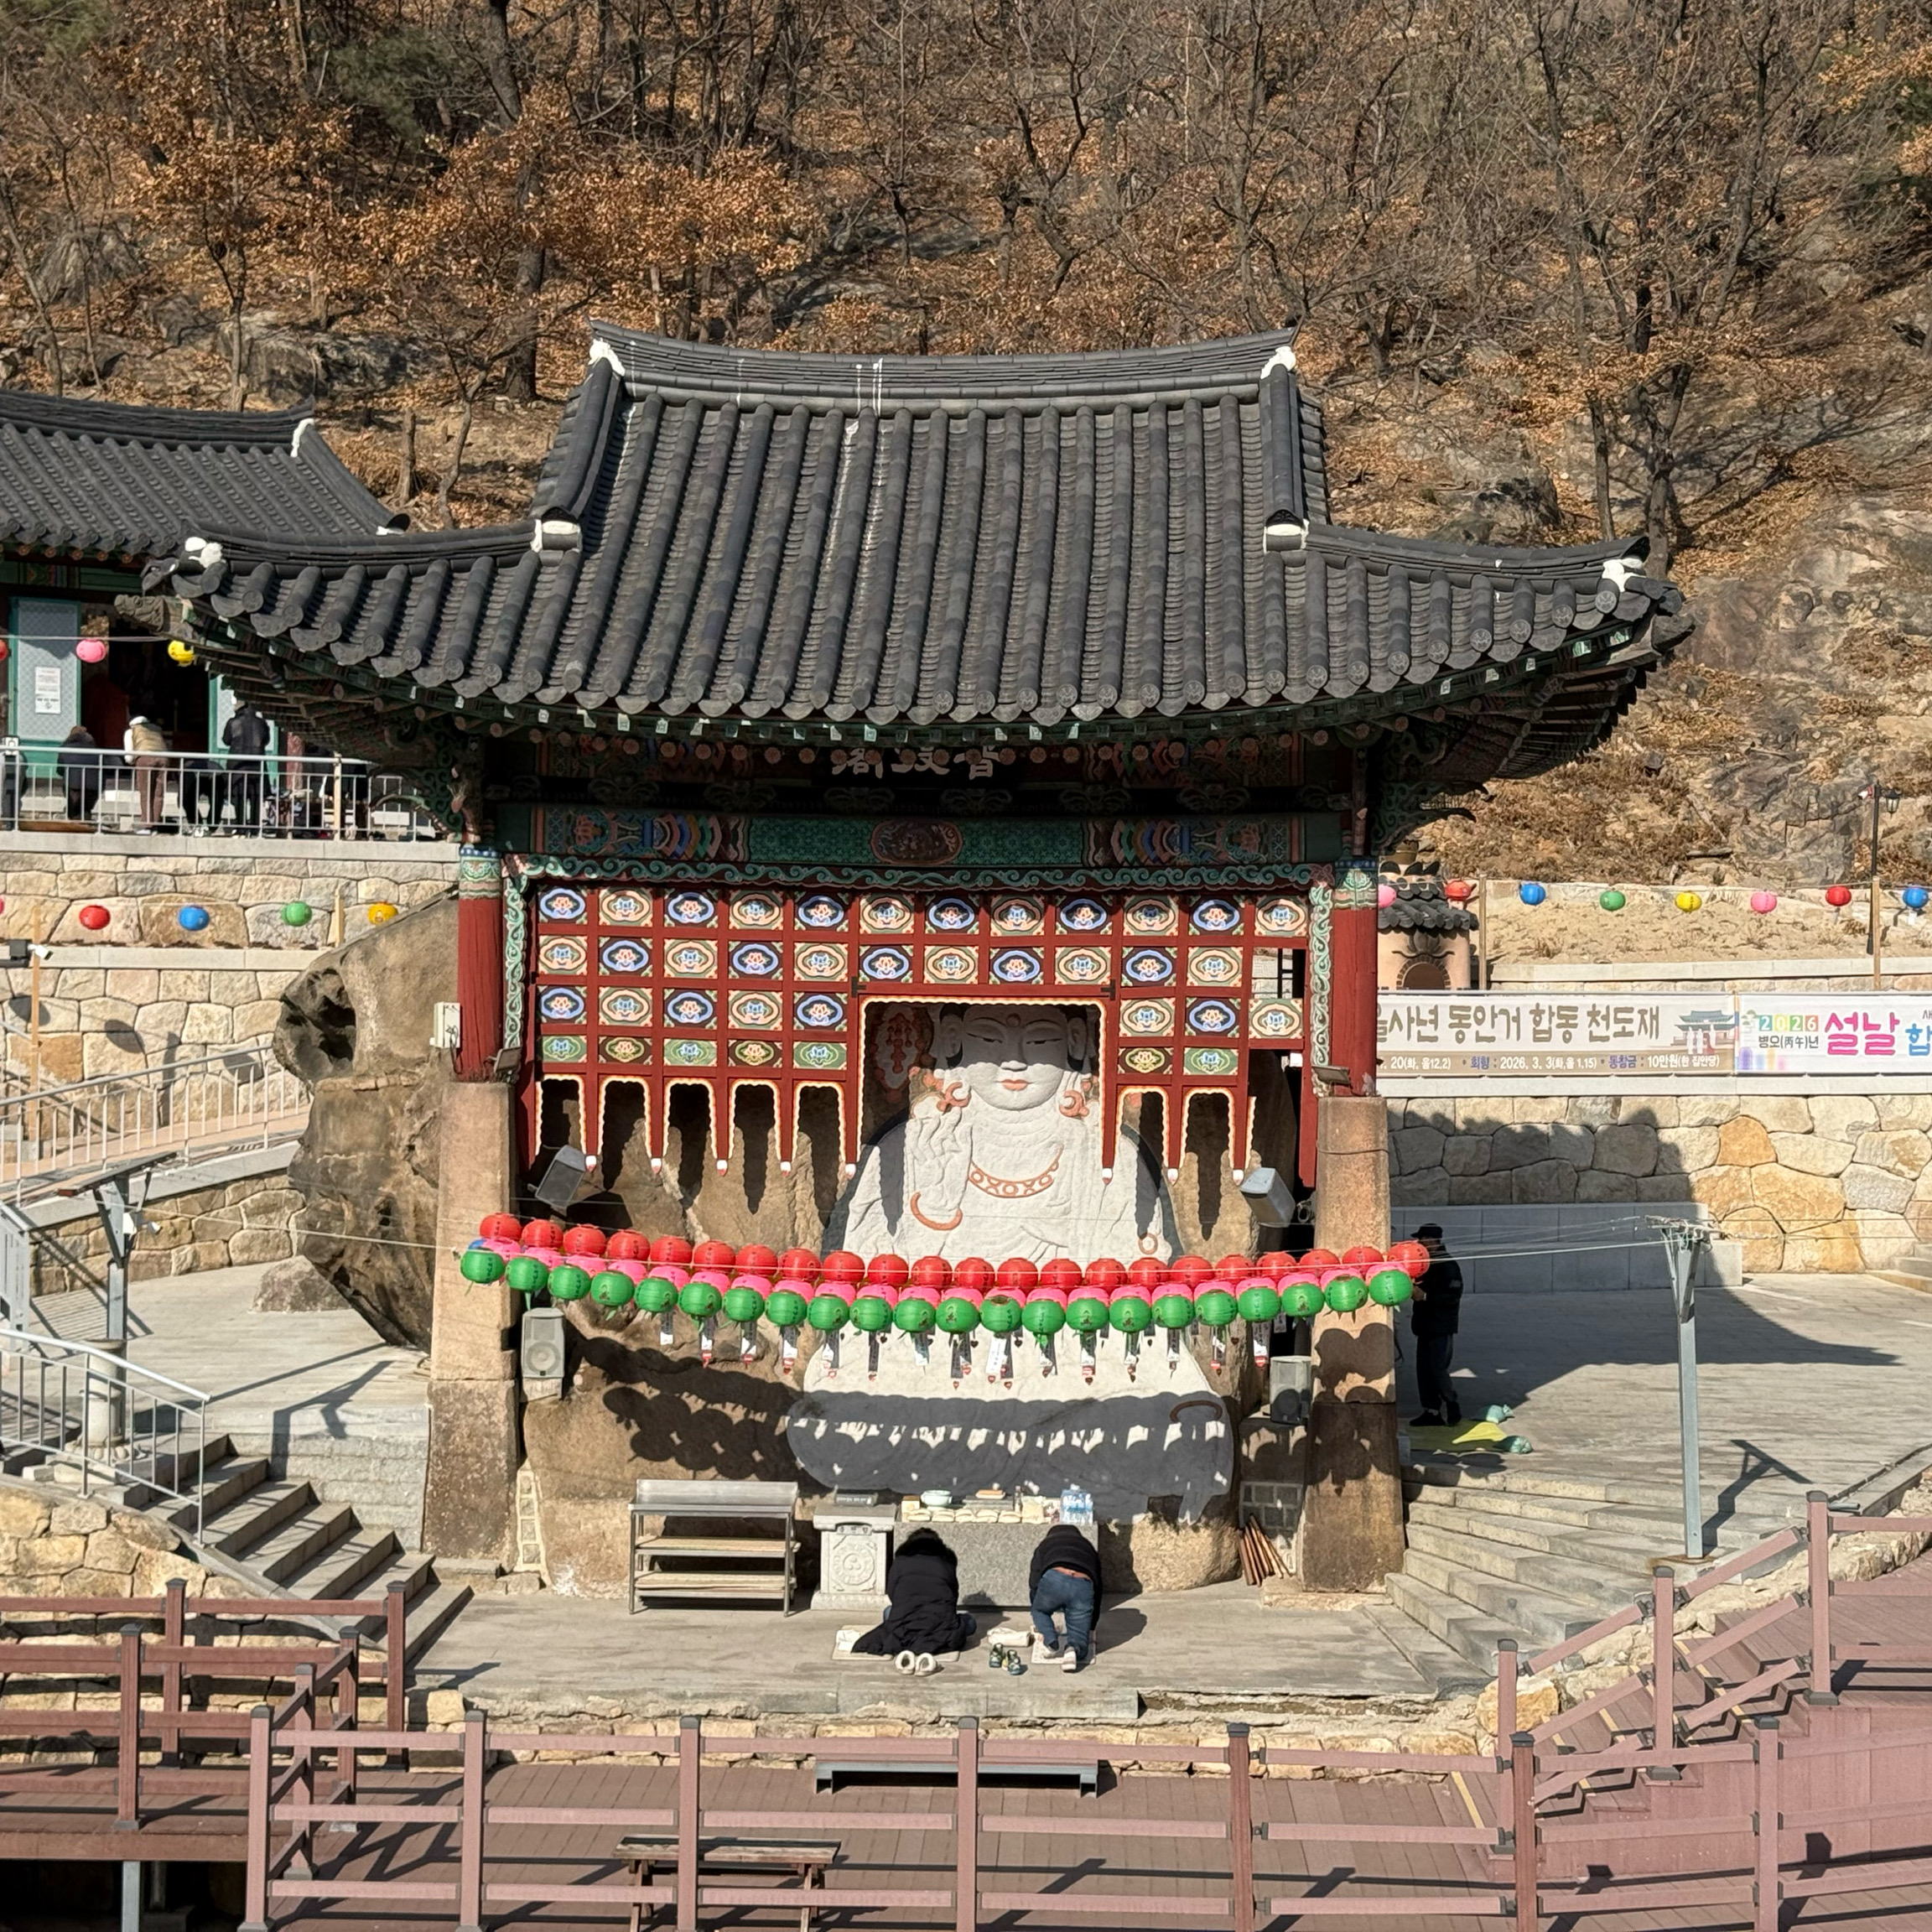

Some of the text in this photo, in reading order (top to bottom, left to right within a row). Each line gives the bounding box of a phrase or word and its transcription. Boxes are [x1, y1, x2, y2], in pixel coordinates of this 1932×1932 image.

[1448, 1005, 1521, 1044] 동안거
[1530, 1002, 1579, 1044] 합동
[1587, 1003, 1659, 1042] 천도재
[1760, 1015, 1817, 1031] 2026
[1825, 1011, 1901, 1056] 설날
[1758, 1036, 1819, 1049] 병오(丙午)년
[1500, 1056, 1529, 1070] 2026.
